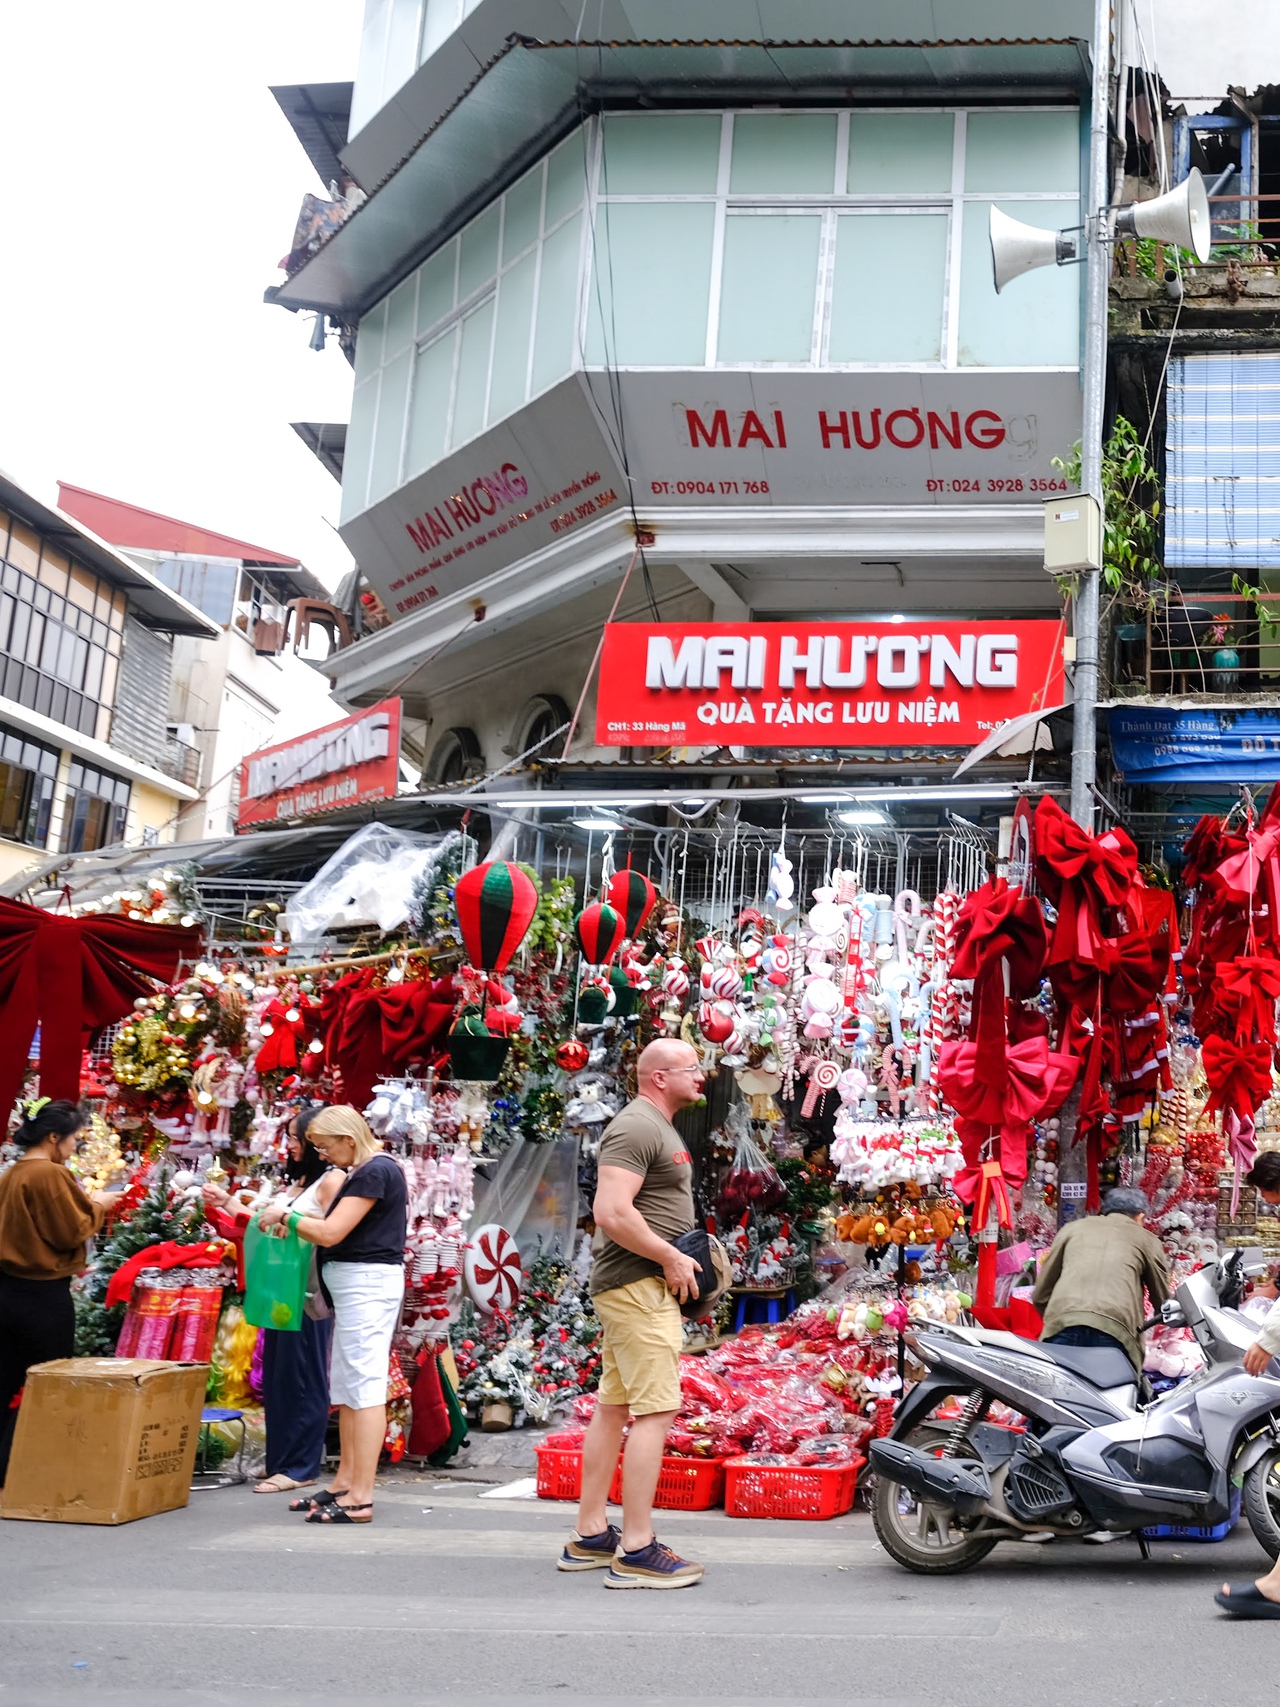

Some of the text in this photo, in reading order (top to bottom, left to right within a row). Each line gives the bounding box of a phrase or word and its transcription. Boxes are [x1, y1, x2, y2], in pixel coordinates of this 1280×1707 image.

[686, 407, 1006, 450] MAI HƯƠNG
[719, 481, 739, 494] 171
[743, 480, 770, 494] 768
[987, 478, 1024, 492] 3928
[1030, 478, 1068, 491] 3564
[405, 462, 528, 554] MAI HƯƠNG
[645, 634, 1019, 690] MAI HƯƠNG
[696, 695, 960, 727] QUÀ TẶNG LƯU NIỆM
[607, 720, 686, 732] CH1: 33 Hàng Mã
[976, 720, 993, 730] Tel:
[1120, 720, 1152, 732] Thành
[1187, 720, 1214, 731] Hàng
